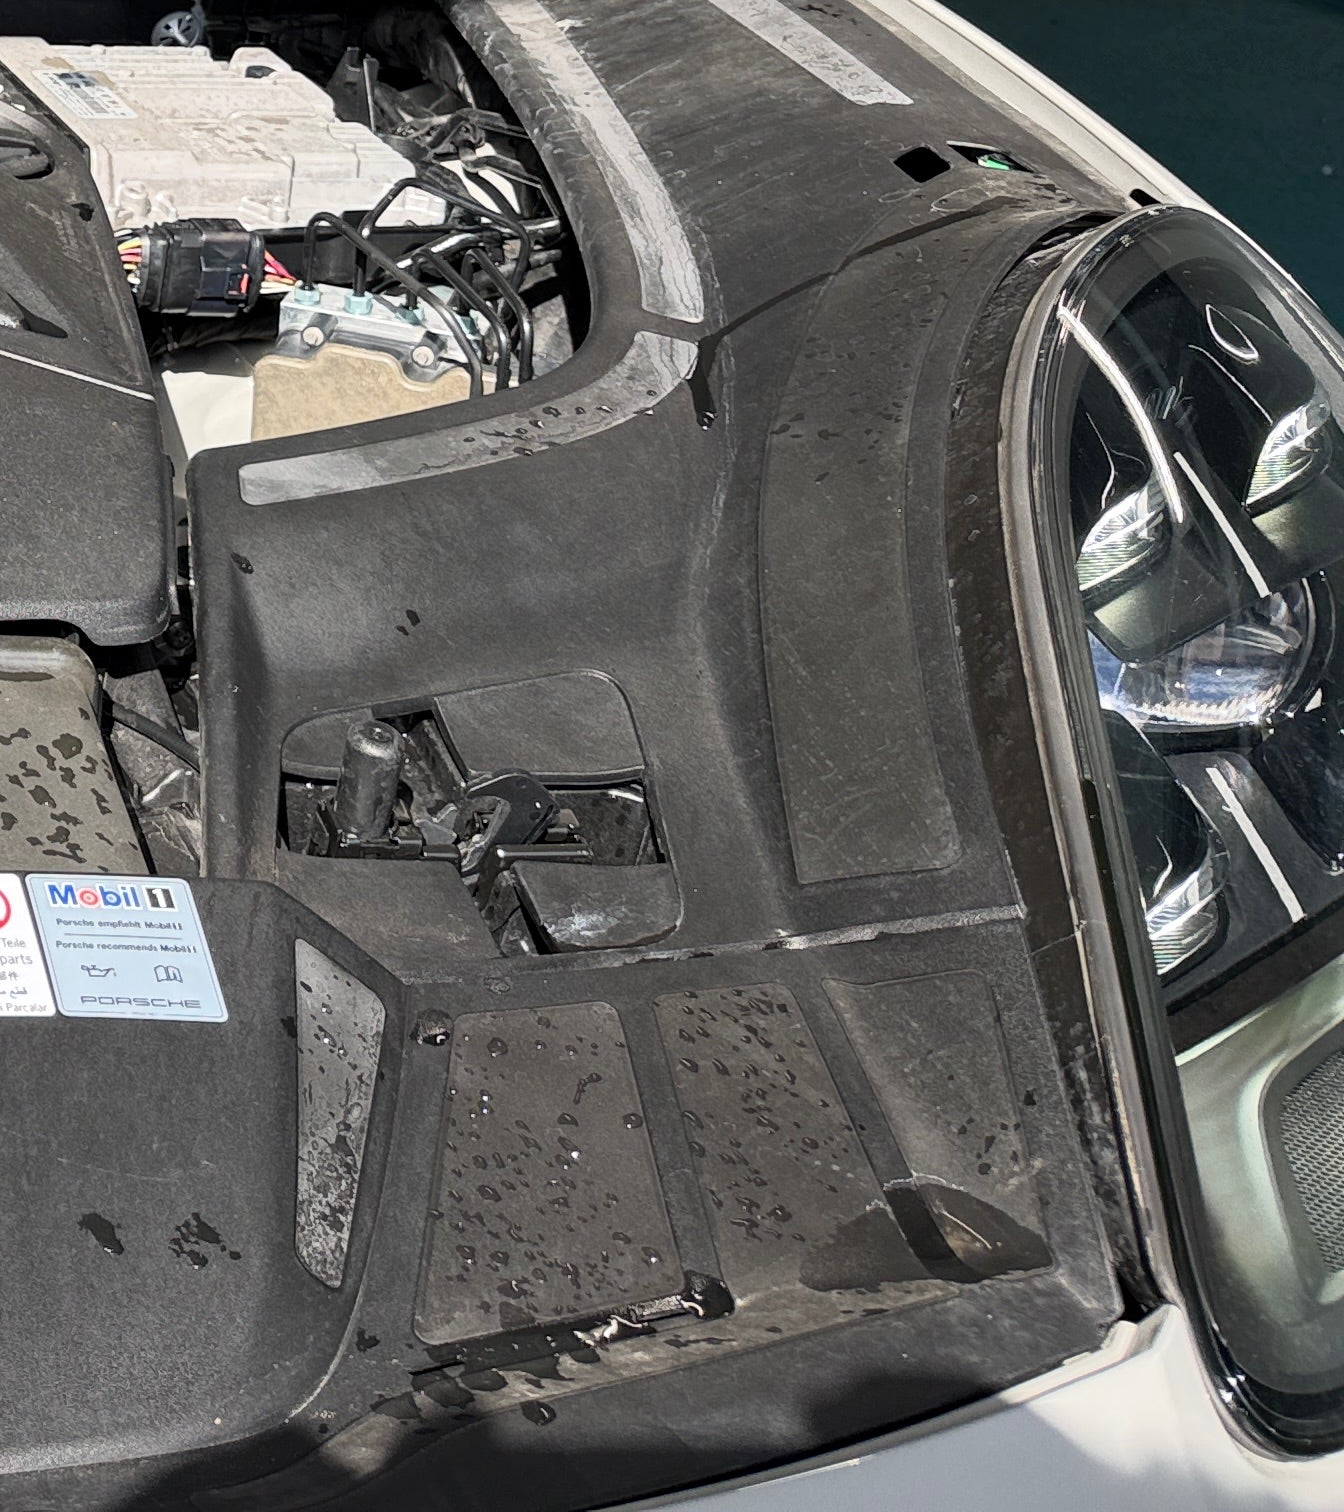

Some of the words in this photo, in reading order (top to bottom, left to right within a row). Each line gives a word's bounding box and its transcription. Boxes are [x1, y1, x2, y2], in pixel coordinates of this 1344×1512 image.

[47, 884, 141, 908] Mobil
[55, 918, 95, 927] Porsche
[98, 920, 141, 929] empfiehlt
[0, 937, 26, 948] Teile
[55, 940, 94, 949] Porsche
[97, 942, 159, 952] recommends
[0, 953, 33, 966] parts
[80, 995, 202, 1009] PORSCHE
